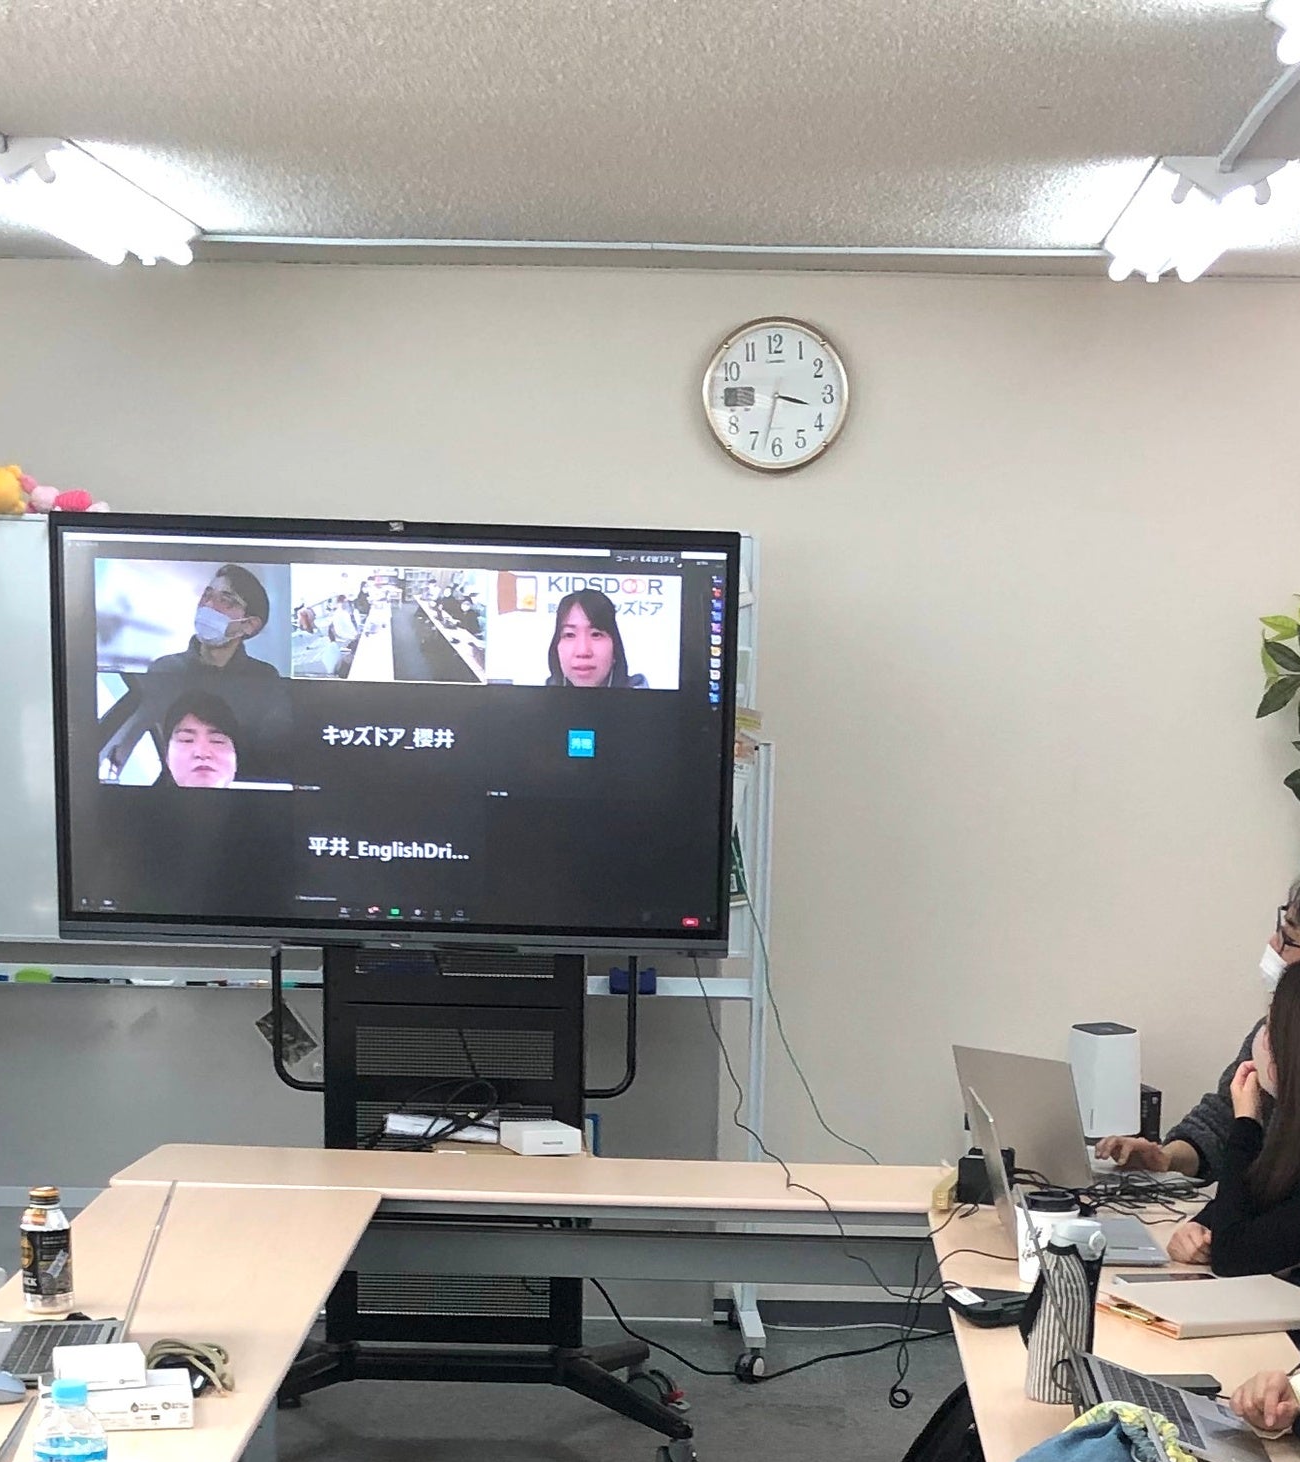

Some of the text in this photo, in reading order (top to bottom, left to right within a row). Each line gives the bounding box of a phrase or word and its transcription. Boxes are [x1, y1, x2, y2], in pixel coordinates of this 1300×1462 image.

[745, 342, 756, 362] 11
[767, 334, 783, 354] 12
[724, 362, 740, 382] 10
[813, 358, 823, 378] 2
[822, 385, 835, 404] 3
[728, 416, 740, 435] 8
[814, 413, 824, 431] 4
[749, 431, 759, 451] 7
[771, 437, 783, 457] 6
[795, 430, 806, 449] 5
